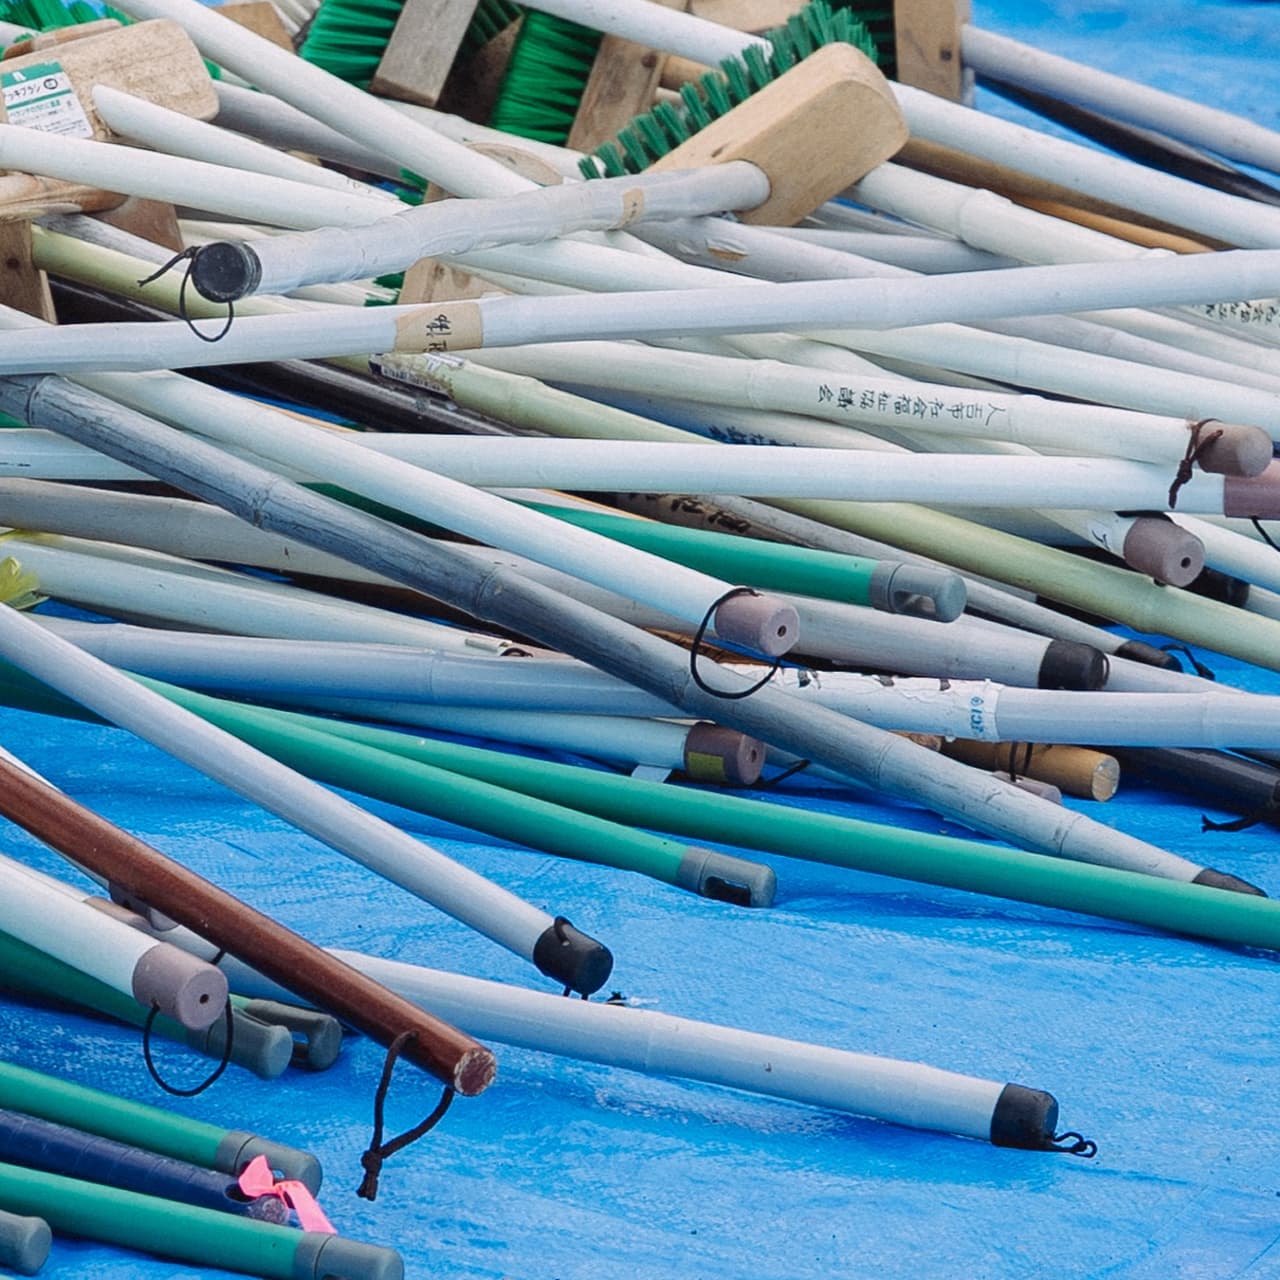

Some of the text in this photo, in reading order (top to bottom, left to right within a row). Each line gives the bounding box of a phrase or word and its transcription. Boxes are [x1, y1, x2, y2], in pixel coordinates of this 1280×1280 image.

[818, 384, 1006, 425] 人吉市社会福祉協議会
